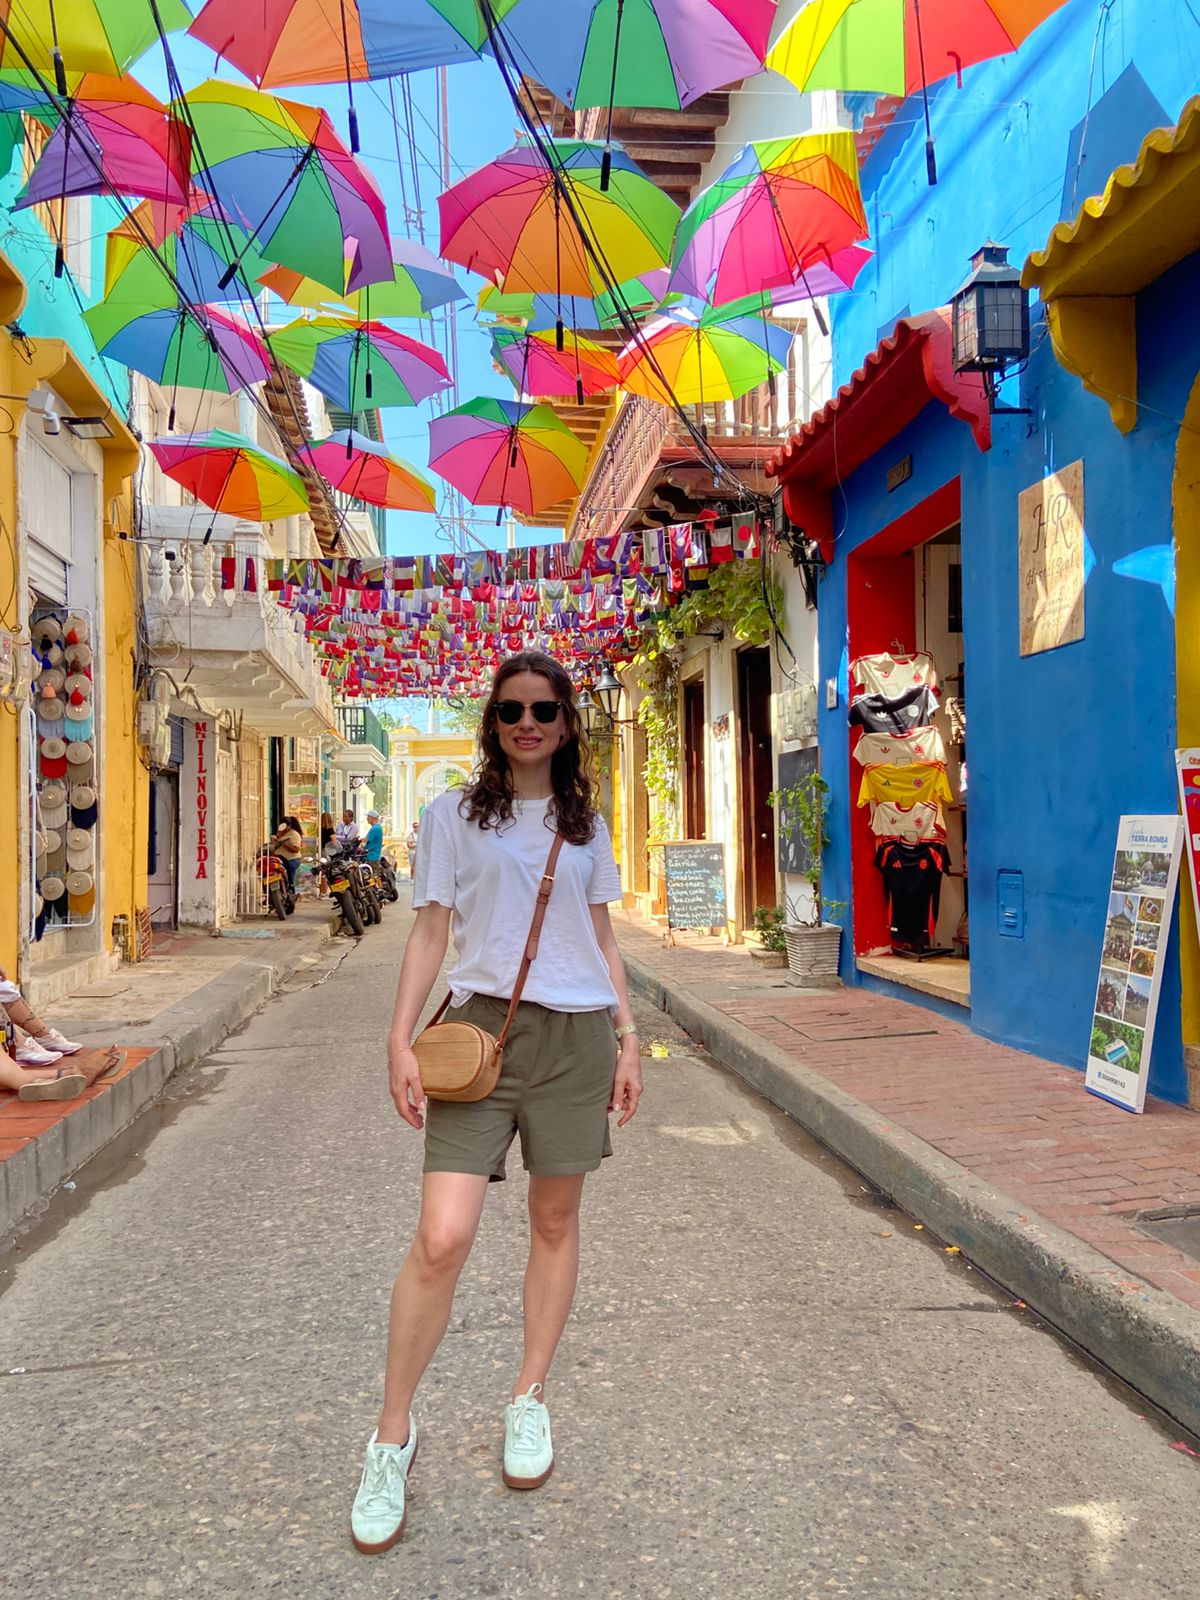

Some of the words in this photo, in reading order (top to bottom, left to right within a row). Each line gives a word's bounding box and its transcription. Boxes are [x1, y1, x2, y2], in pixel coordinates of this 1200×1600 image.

[1032, 492, 1072, 554] HR
[1131, 834, 1148, 843] TIERRA
[1149, 835, 1168, 844] BOMBA
